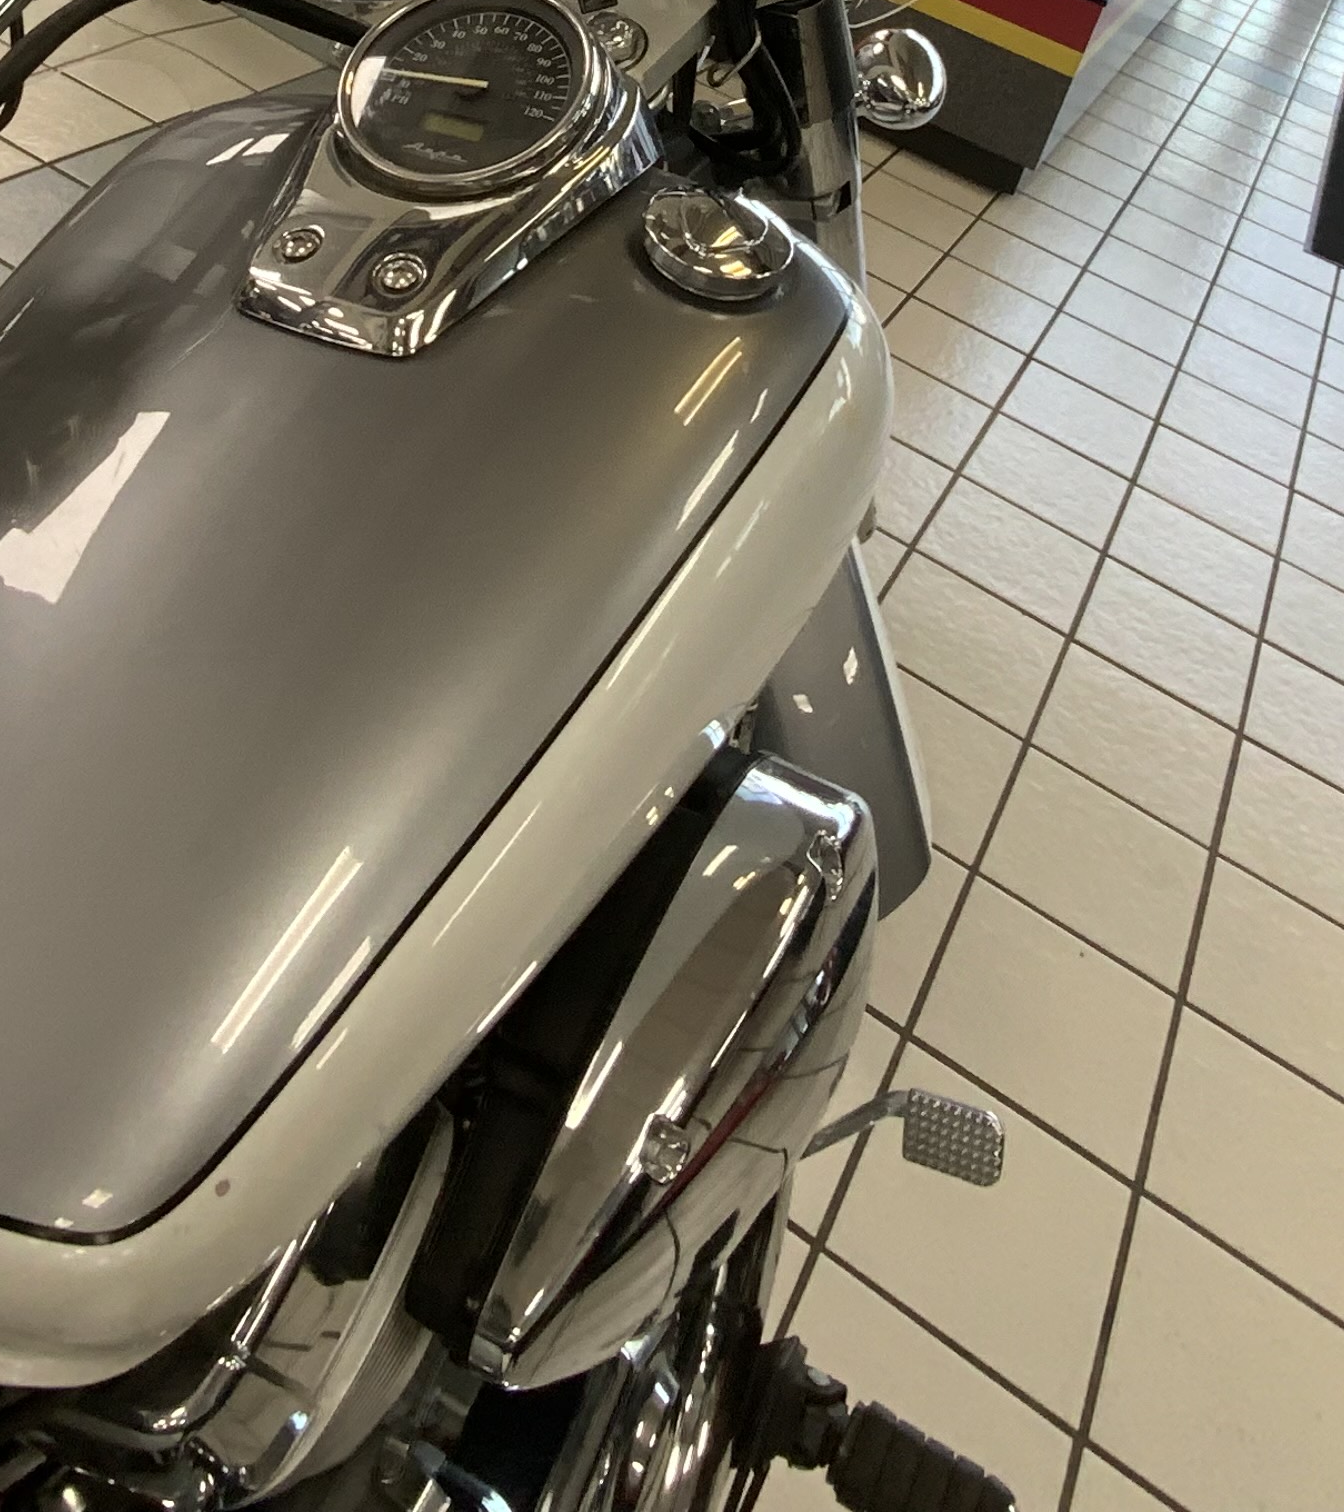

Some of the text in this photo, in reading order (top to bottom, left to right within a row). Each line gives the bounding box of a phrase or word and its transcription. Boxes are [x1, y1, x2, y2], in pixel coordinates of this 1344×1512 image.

[452, 30, 466, 39] 40
[473, 26, 488, 35] 50
[494, 26, 510, 35] 60
[513, 31, 528, 42] 70
[431, 38, 446, 49] 30
[527, 42, 543, 54] 80
[412, 51, 428, 62] 20
[536, 57, 552, 68] 90
[535, 74, 555, 85] 100
[533, 90, 553, 101] 110
[523, 107, 544, 120] 120
